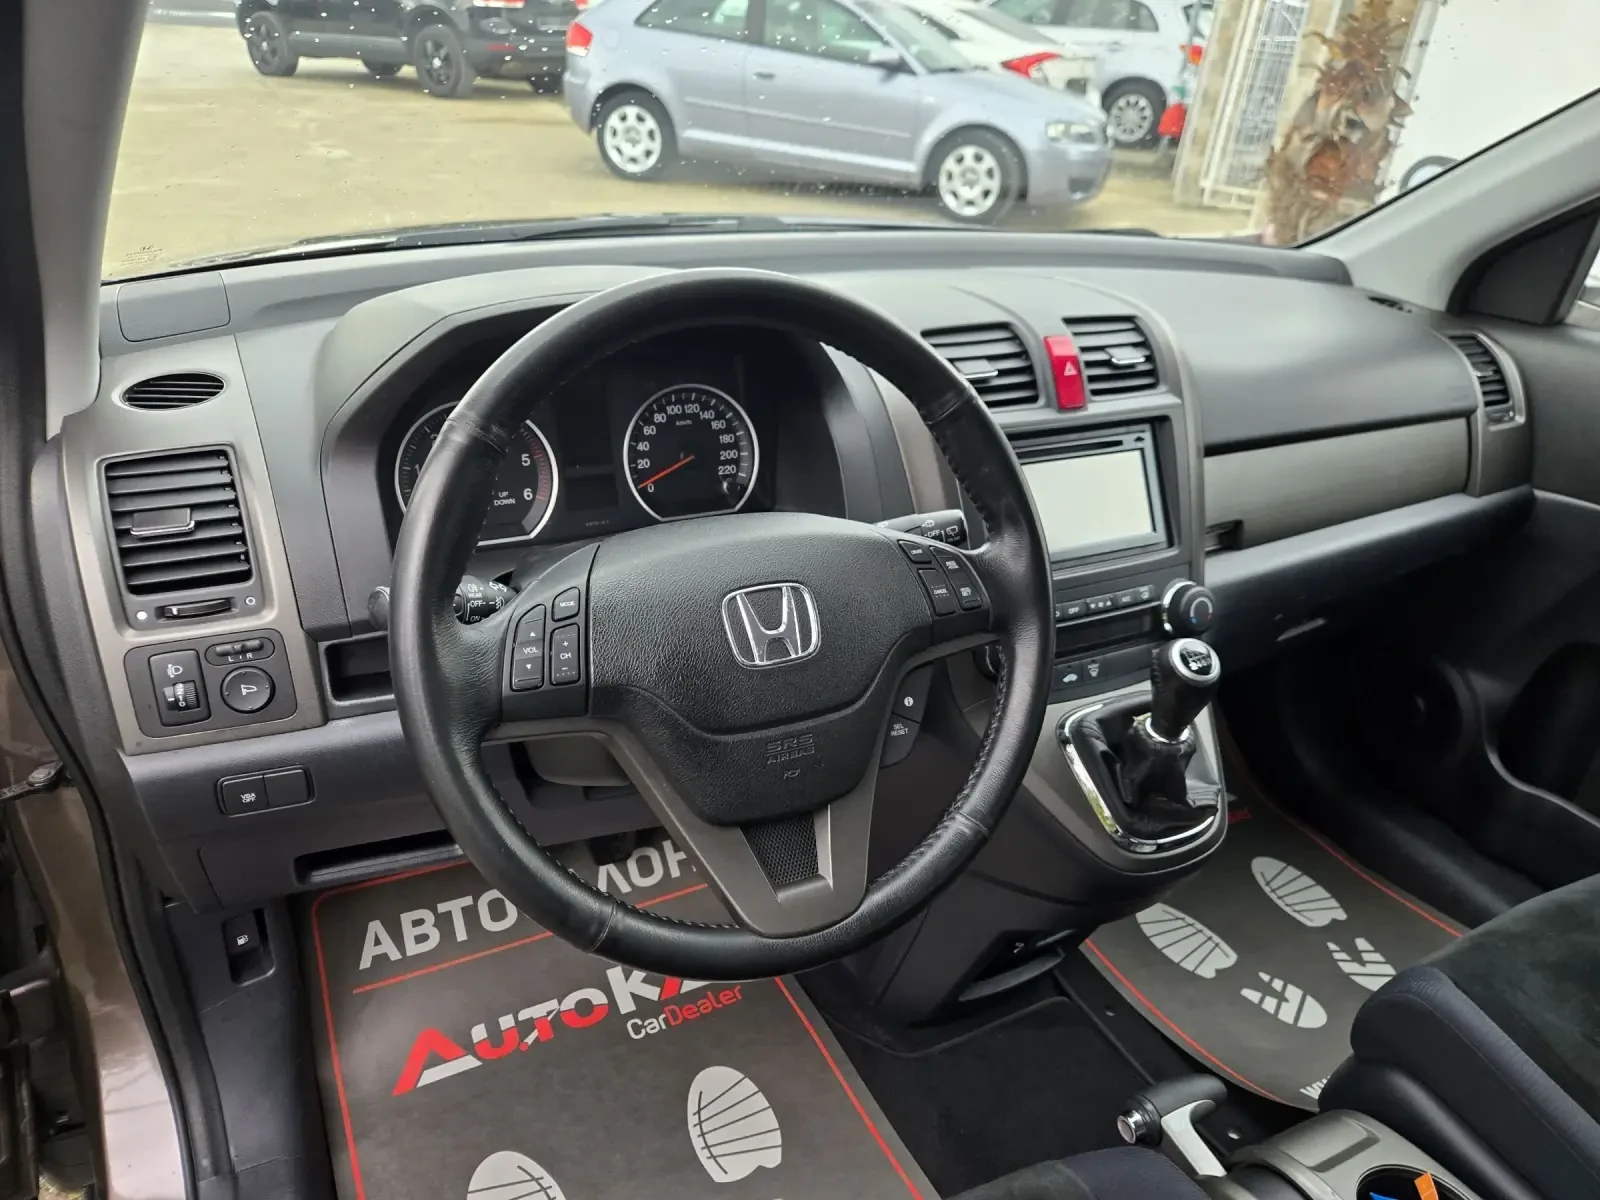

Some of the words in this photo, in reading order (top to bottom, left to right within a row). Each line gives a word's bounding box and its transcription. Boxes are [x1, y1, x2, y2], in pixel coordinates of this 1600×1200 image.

[666, 404, 682, 415] 100
[684, 403, 700, 414] 120
[653, 413, 667, 423] 80
[699, 409, 715, 420] 140
[711, 419, 726, 430] 160
[643, 425, 656, 436] 60
[719, 433, 735, 444] 180
[636, 441, 650, 451] 40
[521, 453, 531, 466] 5
[720, 449, 738, 460] 200
[637, 459, 650, 469] 20
[718, 465, 736, 475] 220
[647, 483, 654, 492] 0
[523, 488, 533, 500] 6
[494, 498, 515, 506] DOWN
[928, 529, 940, 538] OFF
[470, 600, 483, 608] OFF
[522, 646, 539, 654] VOL
[560, 652, 572, 660] CH
[890, 728, 908, 737] RESET
[767, 733, 813, 752] SRS
[626, 985, 743, 1040] CarDealer
